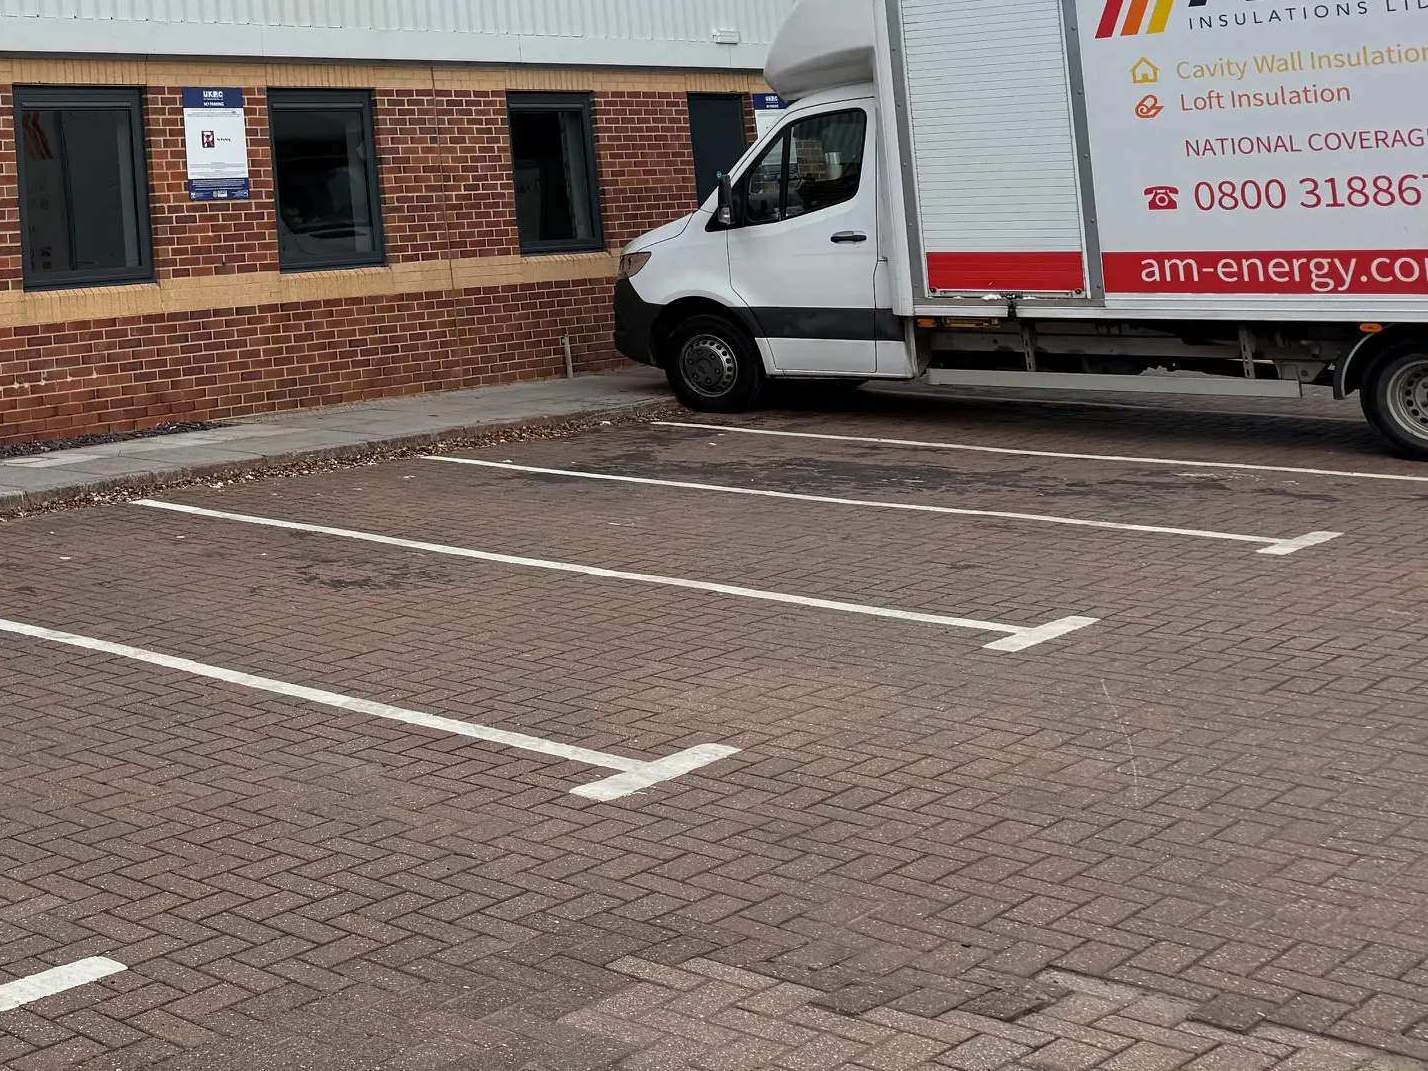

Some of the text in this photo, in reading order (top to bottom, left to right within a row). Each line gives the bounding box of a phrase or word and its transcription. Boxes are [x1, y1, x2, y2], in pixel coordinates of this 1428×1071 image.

[1188, 1, 1368, 30] INSULATIONS
[1176, 57, 1248, 80] Cavity
[1253, 50, 1304, 74] Wall
[1180, 84, 1352, 111] Loft Insulation
[1185, 128, 1428, 157] NATIONAL COVERAG
[1194, 174, 1428, 211] 0800 31886
[1140, 256, 1428, 292] am-energy.co
